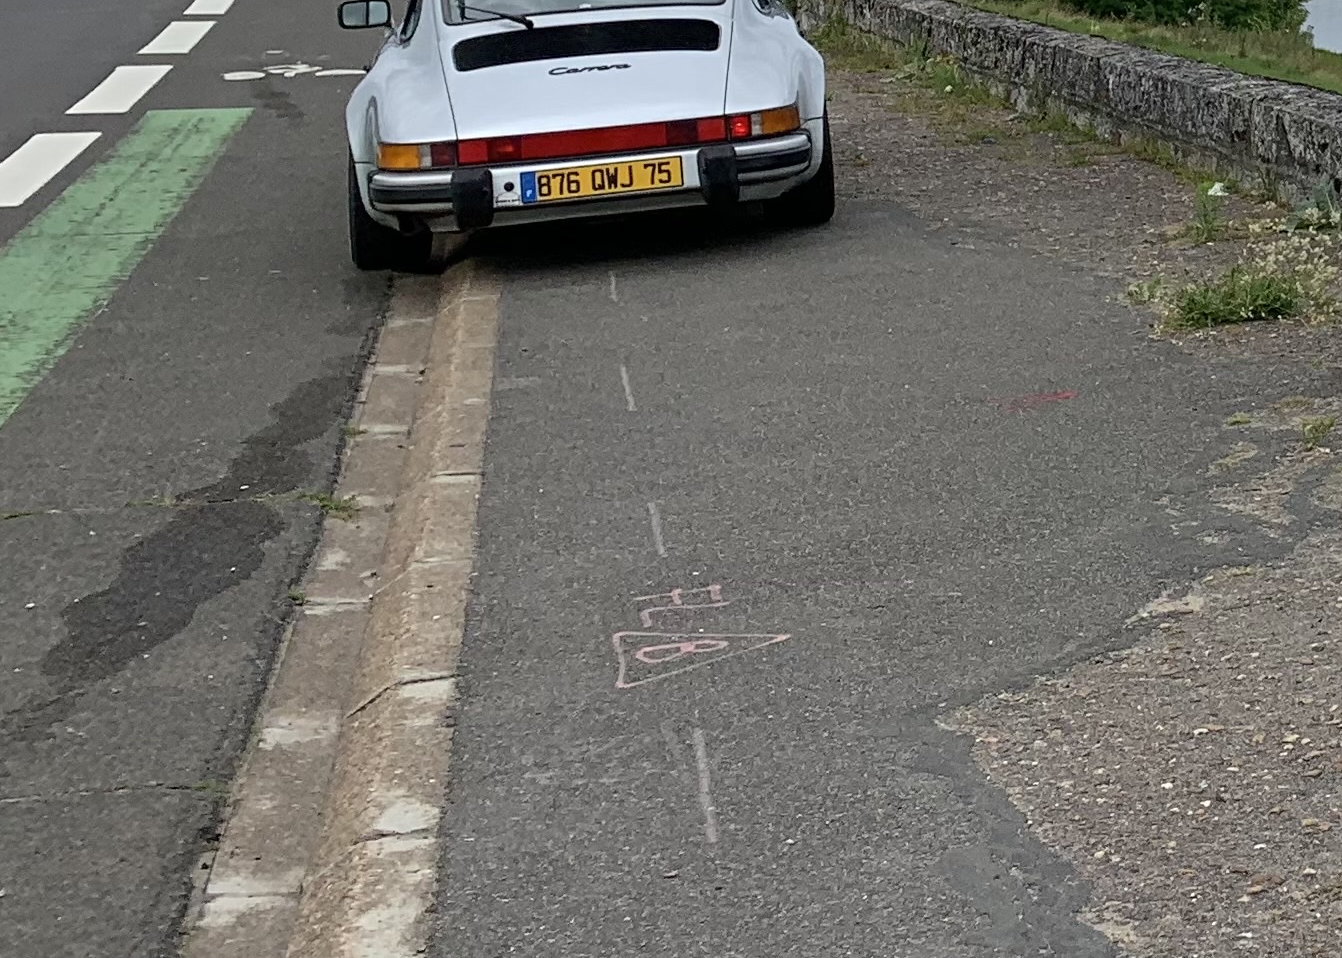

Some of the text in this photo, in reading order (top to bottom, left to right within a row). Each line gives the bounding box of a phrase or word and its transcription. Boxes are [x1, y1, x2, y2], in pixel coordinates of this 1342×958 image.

[548, 63, 632, 76] Carrera
[537, 171, 581, 197] 876
[591, 164, 634, 191] QWJ
[643, 161, 672, 186] 75
